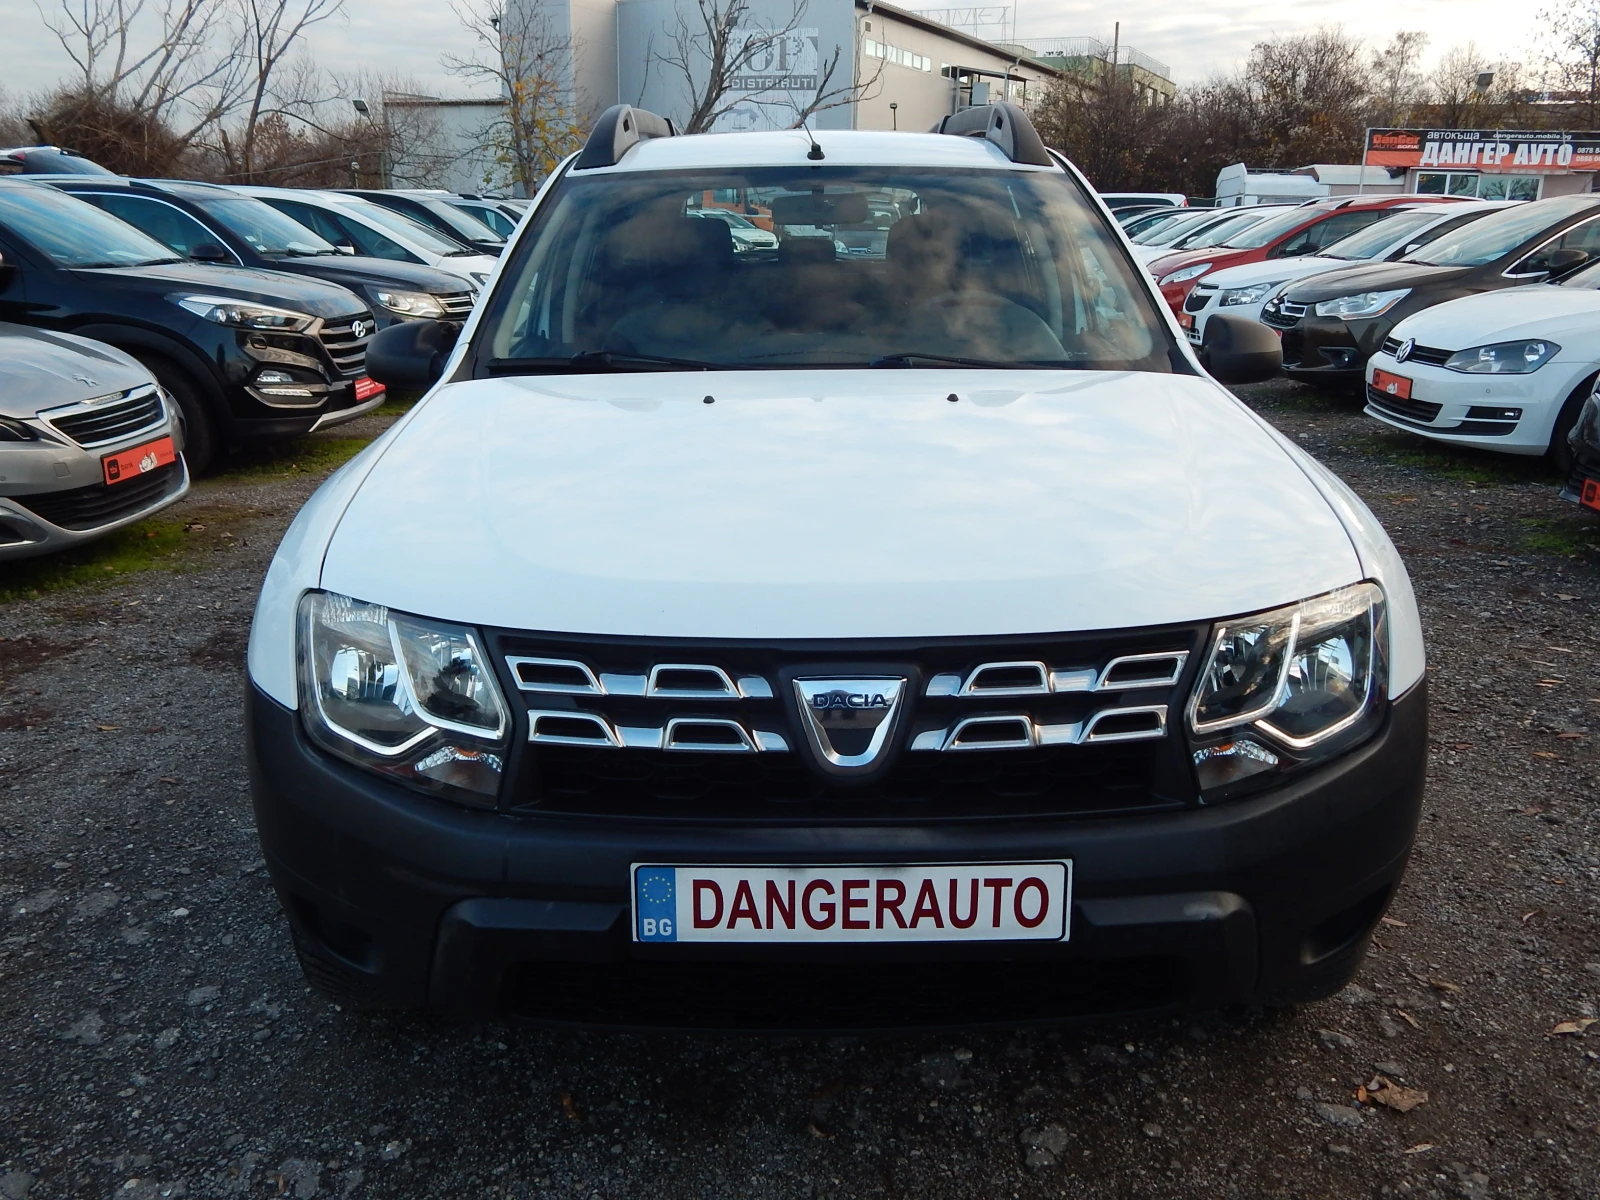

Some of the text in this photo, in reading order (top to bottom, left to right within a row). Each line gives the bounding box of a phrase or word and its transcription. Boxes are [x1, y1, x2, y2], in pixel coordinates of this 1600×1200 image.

[731, 78, 814, 88] DISTRIBUTI
[1427, 131, 1480, 140] автокъща
[1420, 142, 1573, 166] ДАНГЕР АУТО
[813, 694, 888, 708] DACIA
[692, 876, 1050, 930] DANGERAUTO
[643, 918, 672, 936] BG
